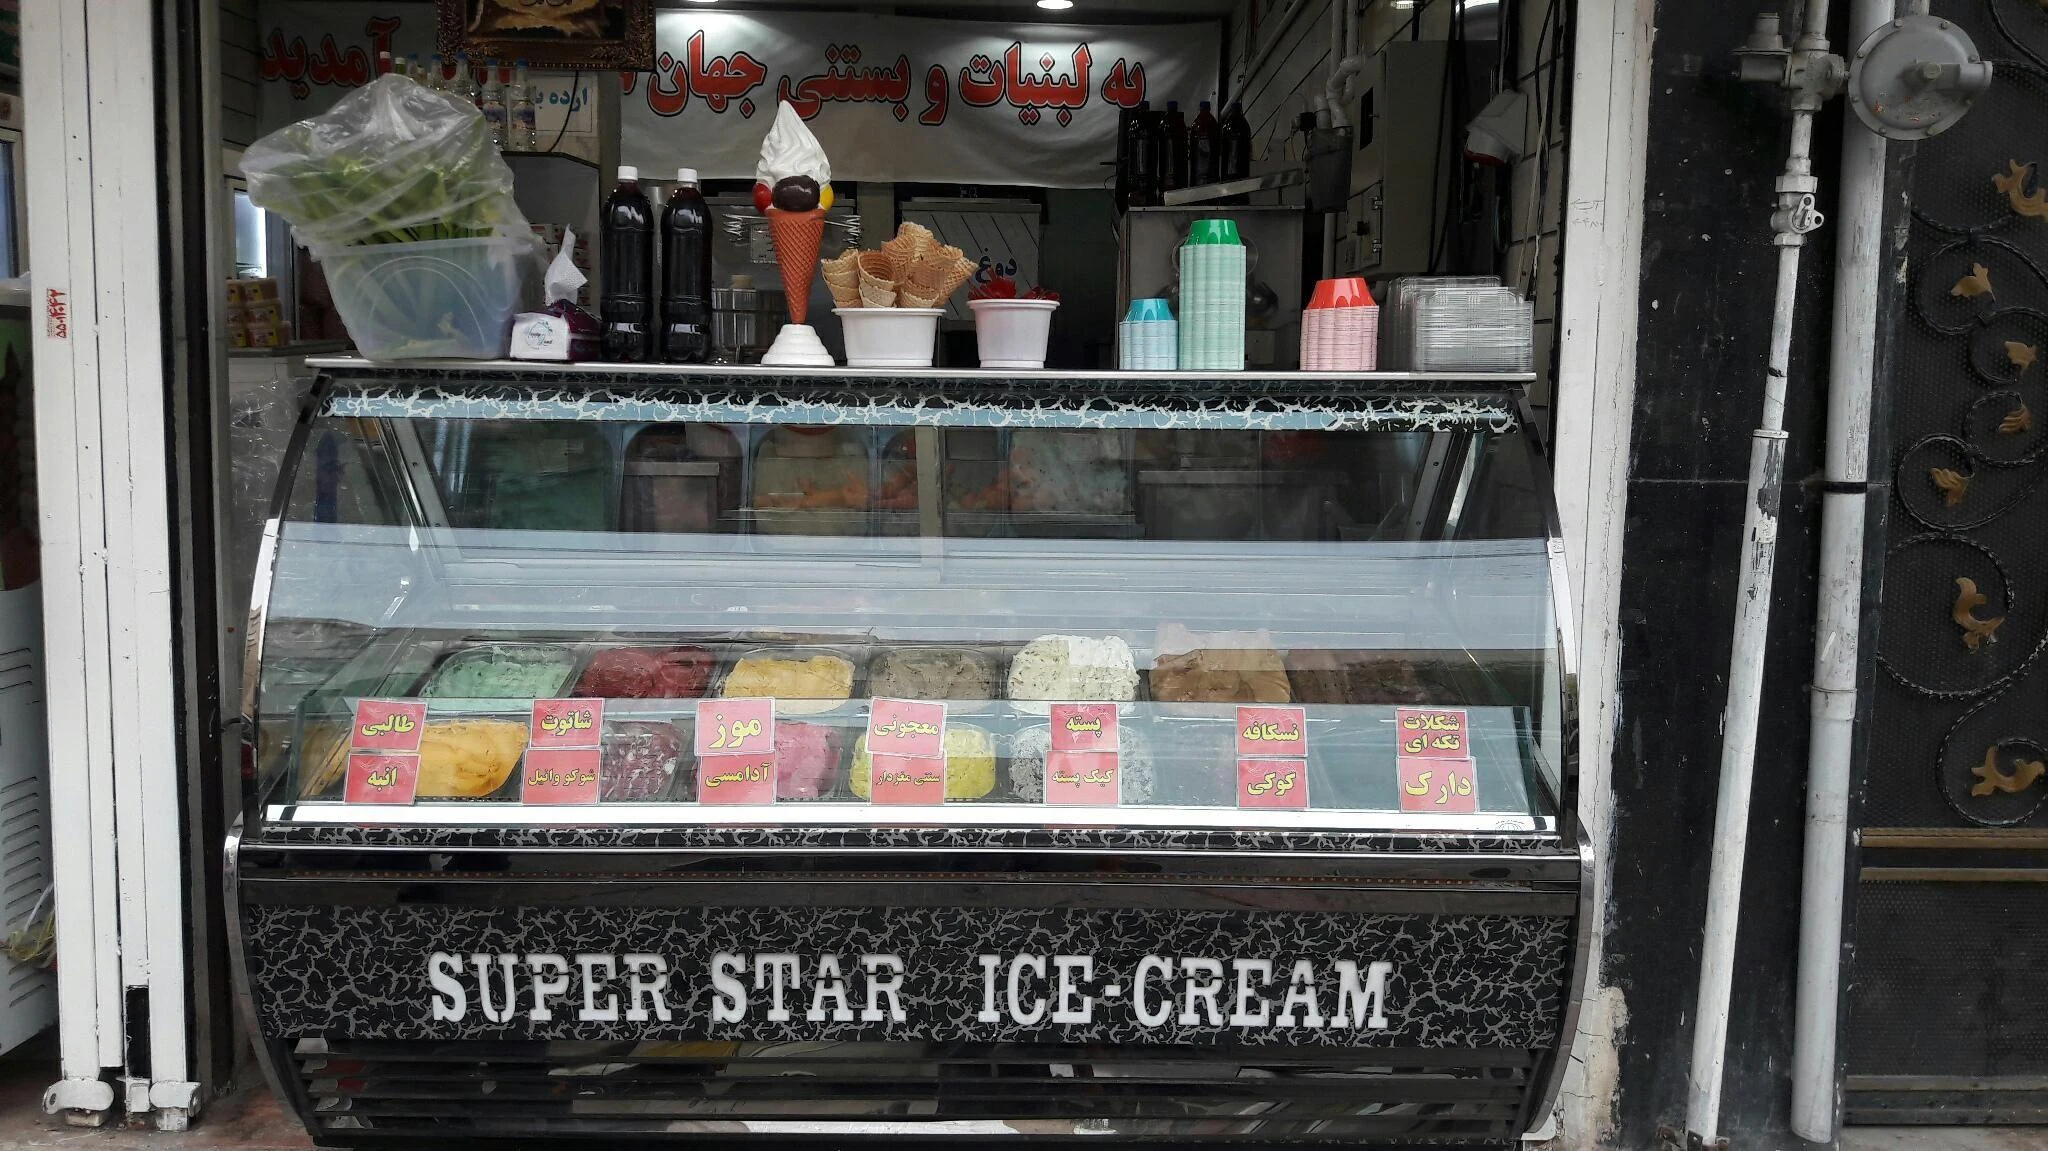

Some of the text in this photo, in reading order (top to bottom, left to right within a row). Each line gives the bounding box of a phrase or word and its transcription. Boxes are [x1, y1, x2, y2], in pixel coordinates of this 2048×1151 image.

[258, 16, 400, 99] آمدید
[647, 30, 767, 118] جهان
[777, 44, 911, 122] بستنی
[958, 41, 1092, 127] لبنیات
[918, 64, 950, 126] و
[974, 247, 1018, 284] دوغ
[361, 714, 415, 736] طالبی
[541, 711, 593, 736] شاتوت
[708, 714, 762, 748] موز
[874, 714, 939, 738] معجونی
[1065, 714, 1102, 738] پسته
[1242, 721, 1299, 742] نسکافه
[1403, 713, 1460, 731] شکلات
[1405, 733, 1460, 753] تکه ای
[367, 767, 398, 790] انبه
[528, 768, 560, 786] وانیل
[704, 762, 772, 789] آدامسی
[914, 771, 941, 786] سنتی
[1052, 768, 1114, 788] کیک پسته
[1247, 772, 1296, 797] کوکی
[1405, 771, 1472, 804] دارک
[427, 950, 1393, 1030] SUPER STAR ICE-CREAM
